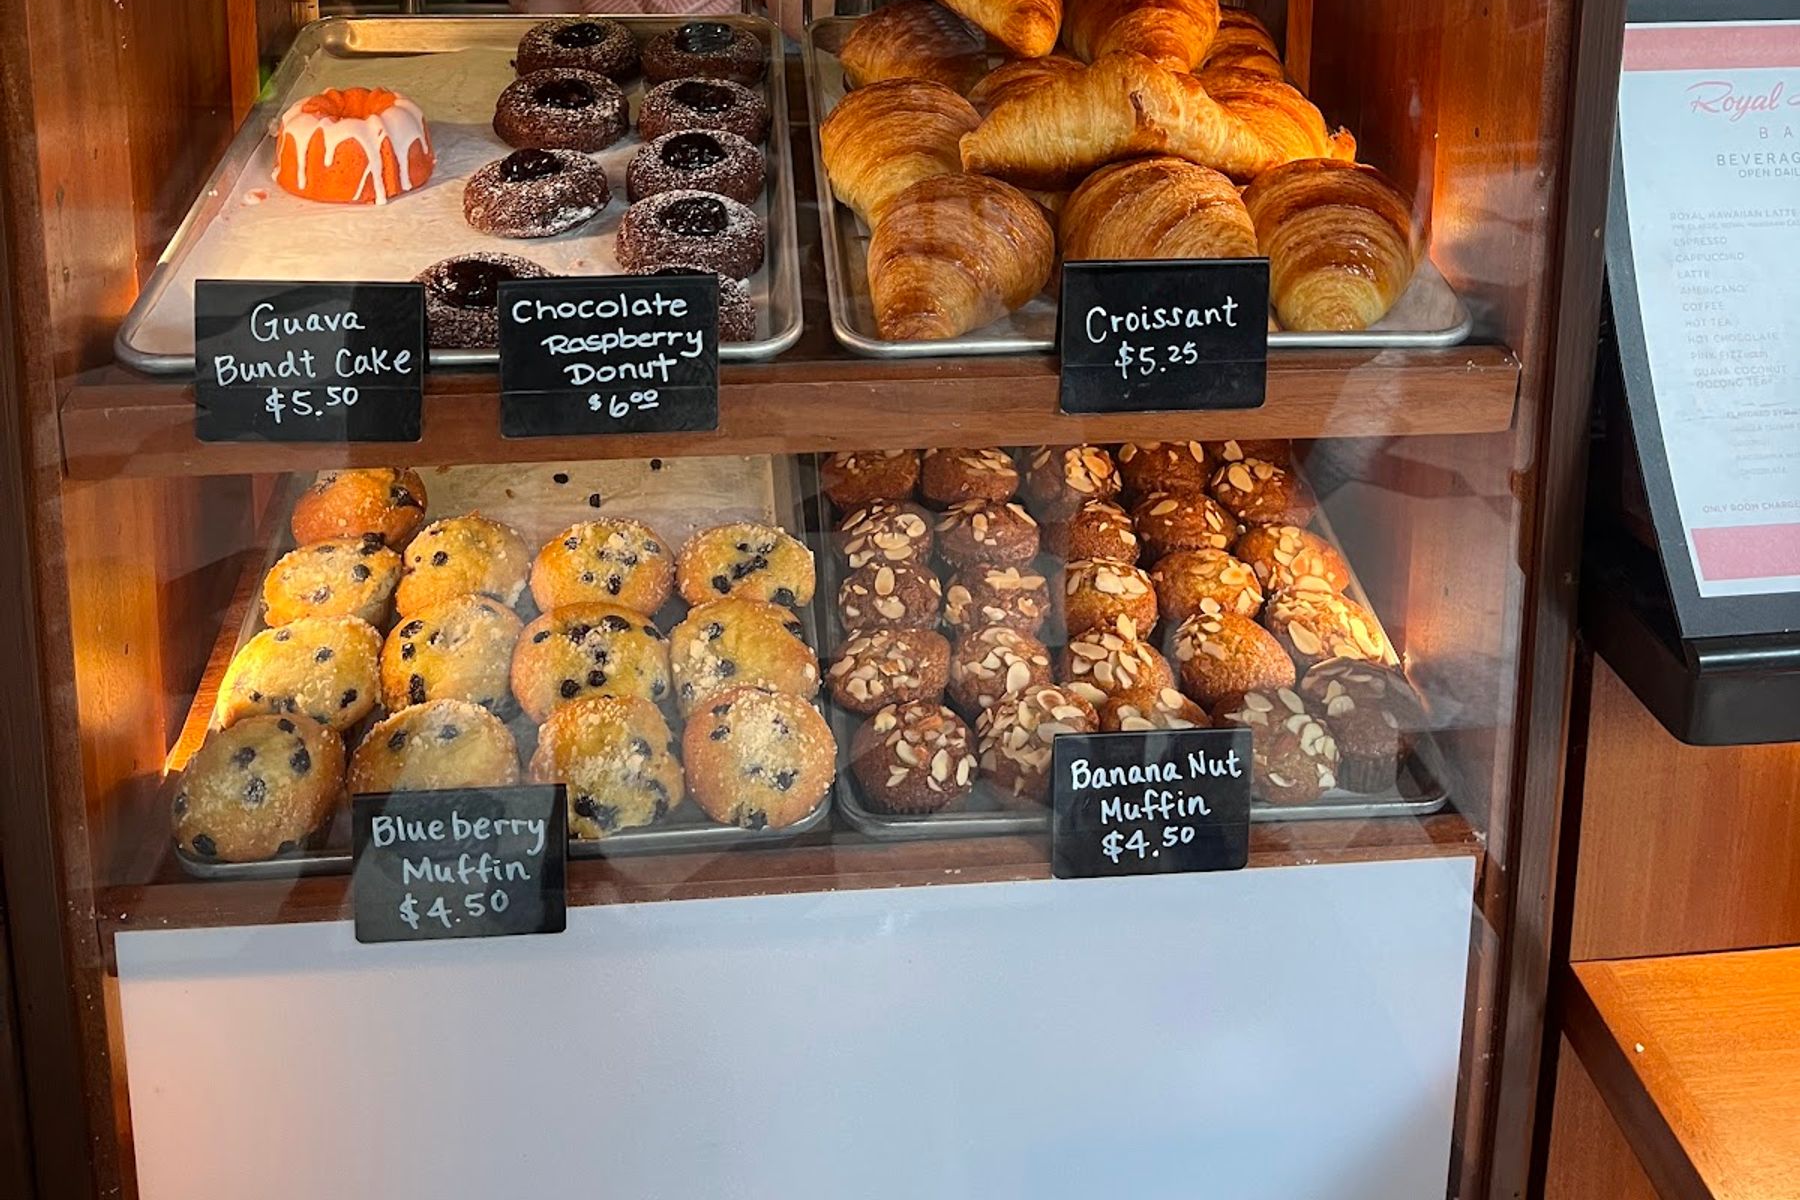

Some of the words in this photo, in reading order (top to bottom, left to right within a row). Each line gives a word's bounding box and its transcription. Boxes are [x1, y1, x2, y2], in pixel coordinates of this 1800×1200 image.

[1685, 80, 1785, 121] Royal
[1738, 168, 1770, 178] OPEN
[250, 303, 365, 342] Guava
[512, 293, 688, 323] Chocolate
[1086, 296, 1239, 343] Croissant
[1682, 301, 1725, 311] COFFEE
[541, 327, 703, 357] Raspberry
[1114, 341, 1199, 380] $5.25
[214, 349, 316, 386] Bundt
[335, 347, 412, 378] Cake
[563, 352, 678, 385] Donut
[265, 386, 359, 423] $5.50
[1702, 503, 1728, 513] ONLY
[1070, 758, 1183, 790] Banana
[1188, 749, 1242, 778] Nut
[1100, 789, 1211, 825] Muffin
[372, 810, 545, 856] Blueberry
[1101, 826, 1196, 863] $4.50
[403, 852, 531, 884] Muffin
[399, 889, 510, 930] $4.50
